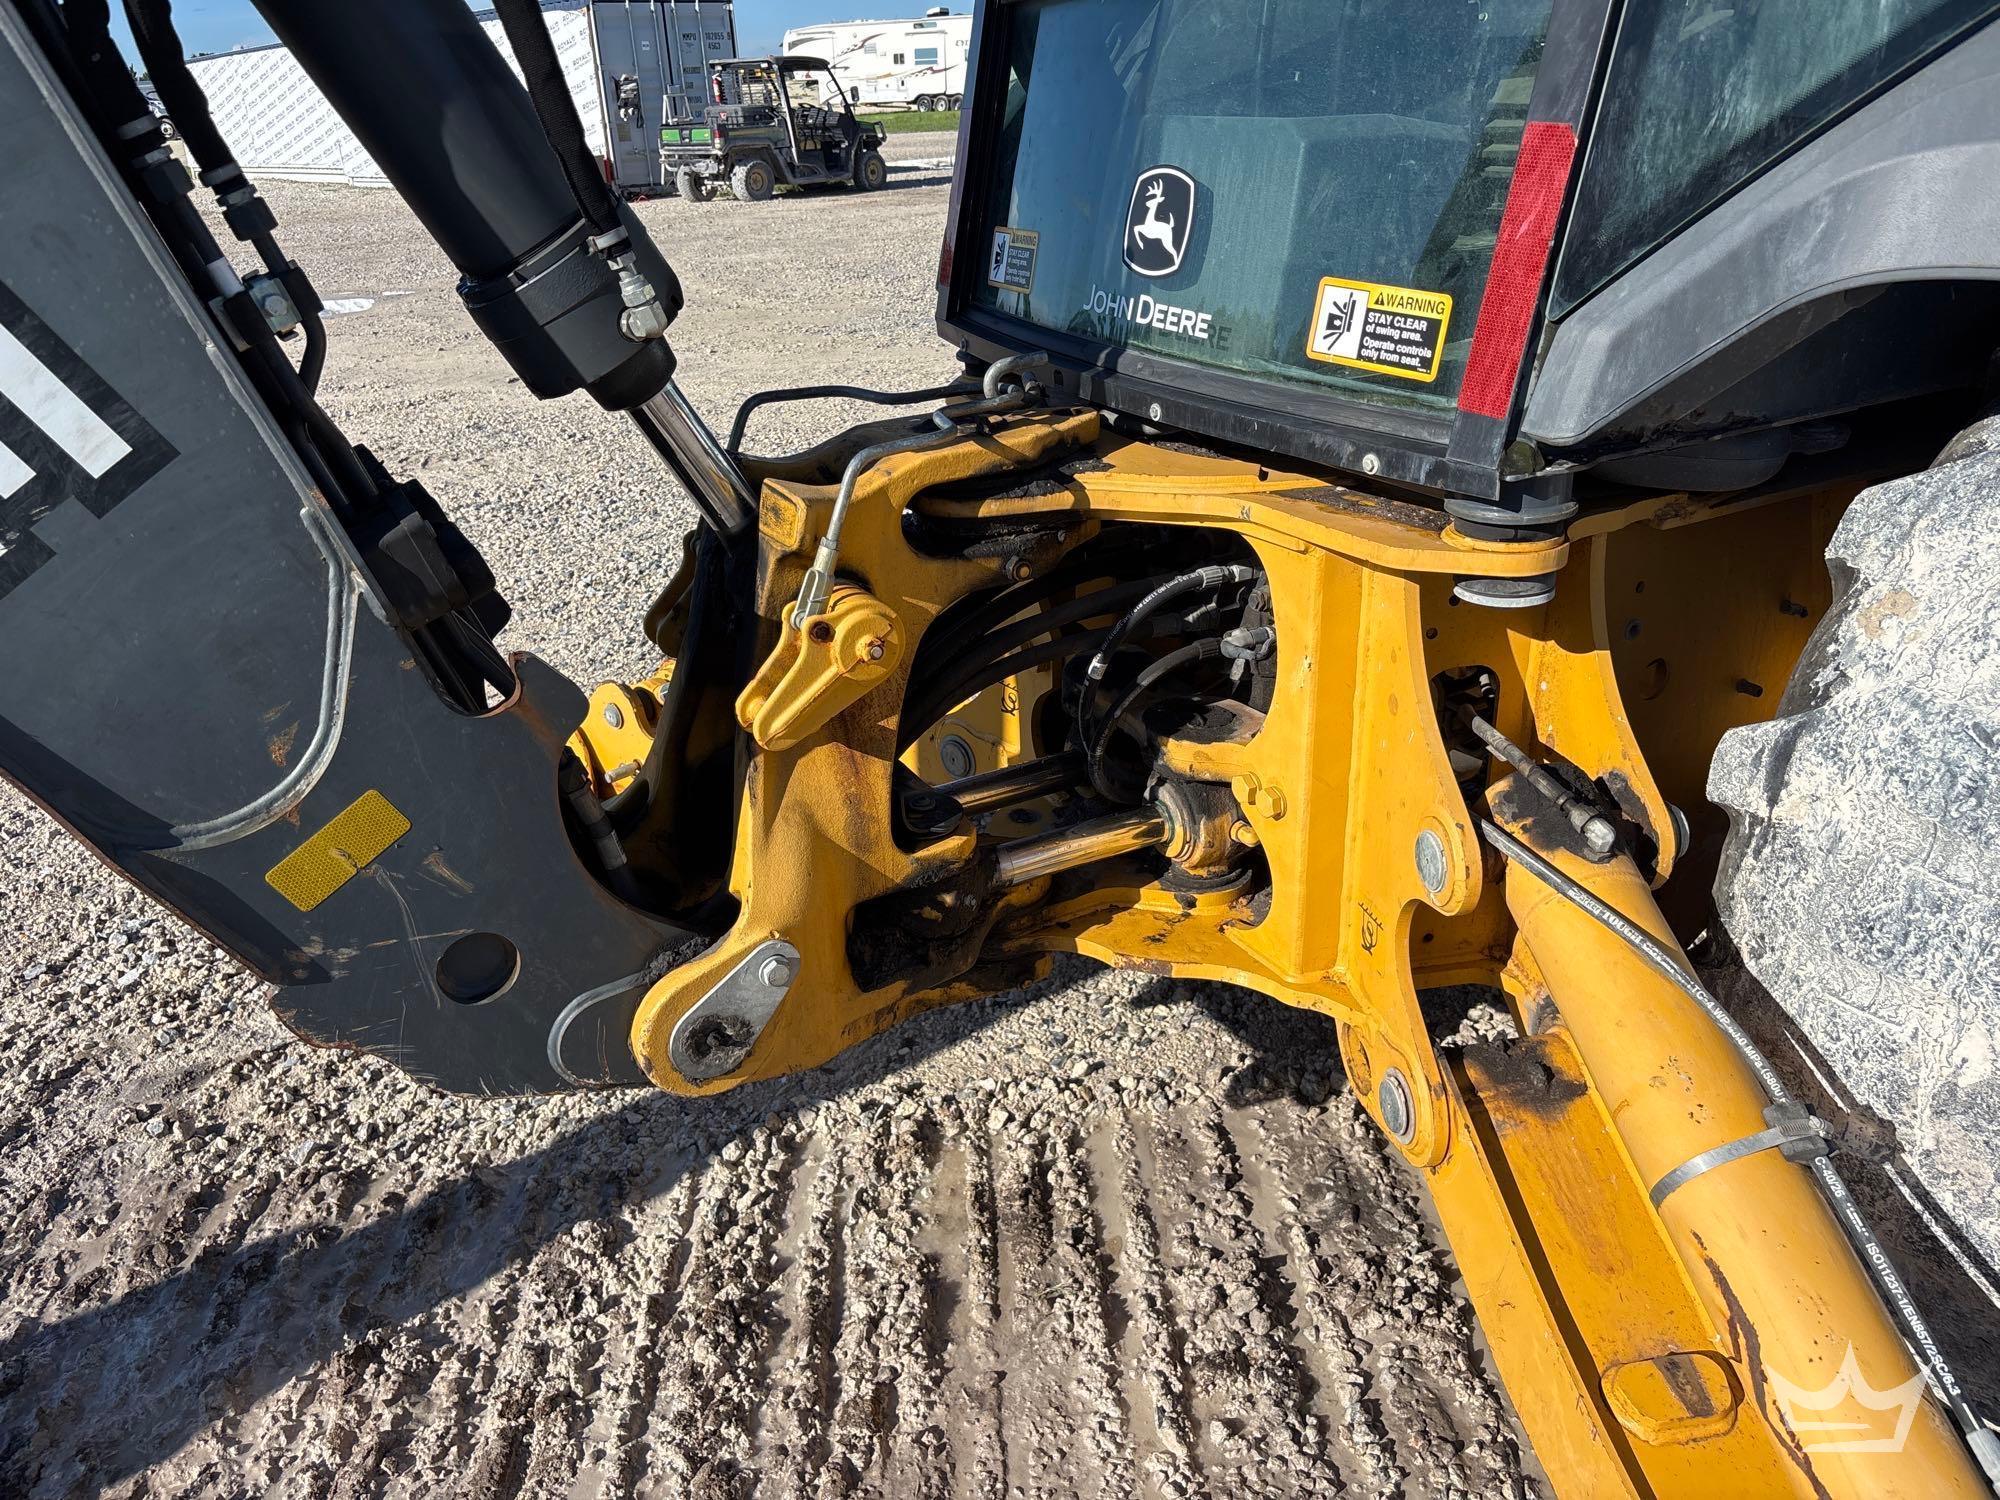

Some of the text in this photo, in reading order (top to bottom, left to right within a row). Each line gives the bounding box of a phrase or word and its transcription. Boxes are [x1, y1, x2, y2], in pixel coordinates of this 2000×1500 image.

[1083, 284, 1212, 339] JOHN DEERE
[1386, 293, 1446, 315] WARNING
[1365, 324, 1423, 342] of swing area.
[1367, 312, 1428, 332] STAY CLEAR
[1361, 348, 1422, 367] only from seat.
[1363, 336, 1432, 358] Operate controls
[1743, 1044, 1765, 1069] MPa
